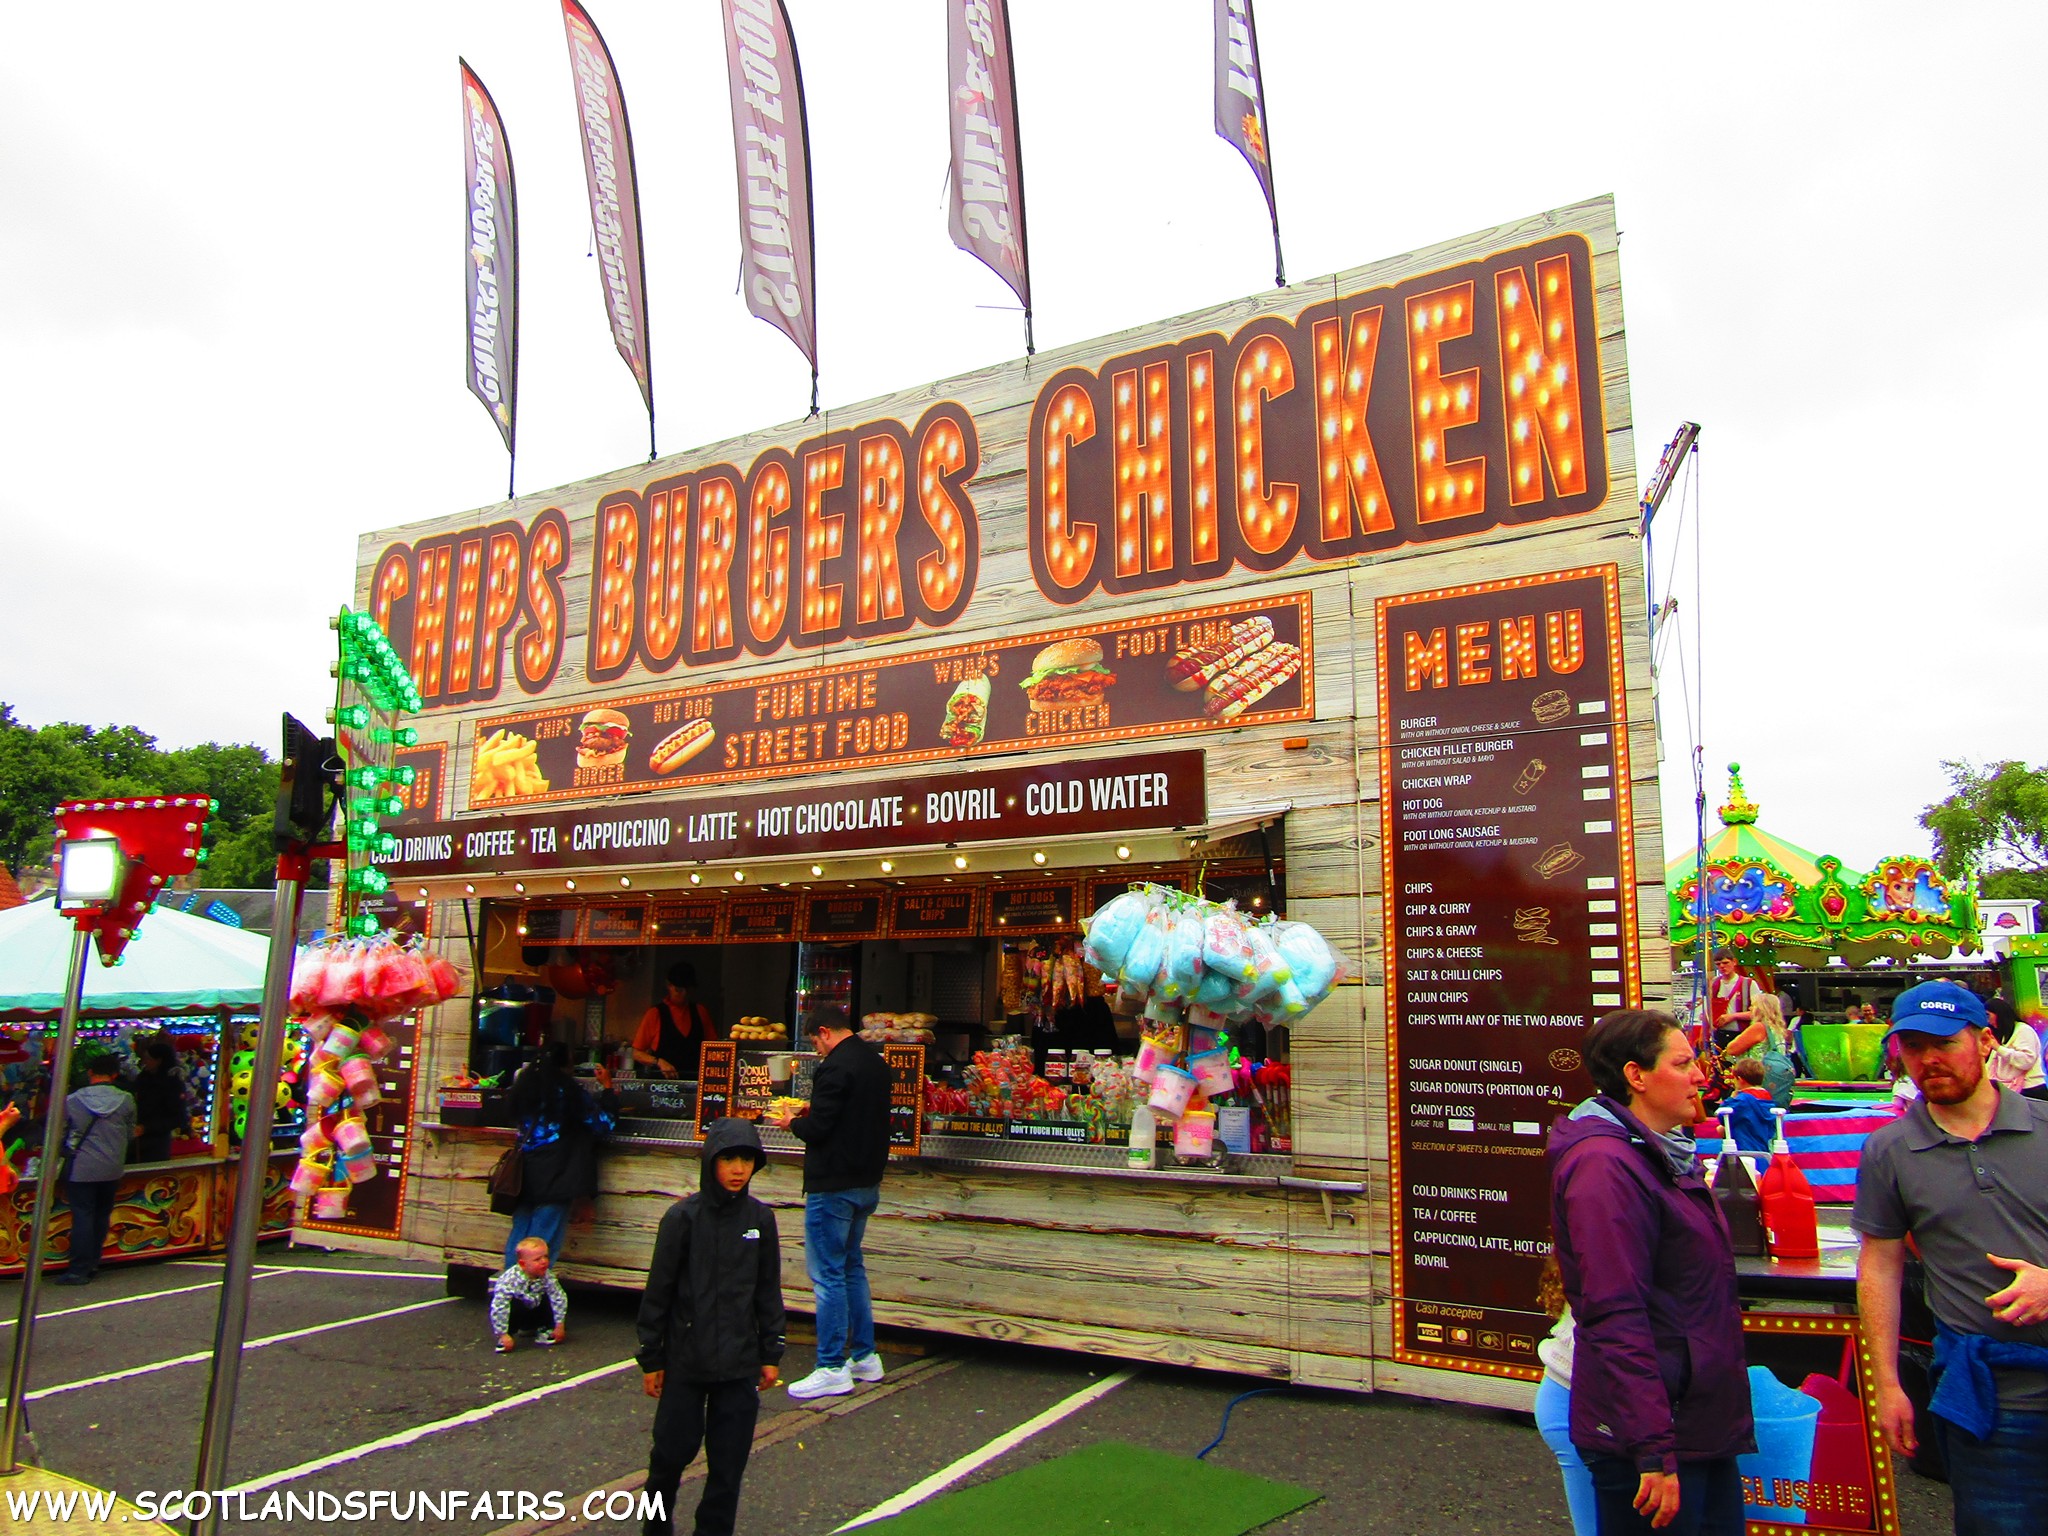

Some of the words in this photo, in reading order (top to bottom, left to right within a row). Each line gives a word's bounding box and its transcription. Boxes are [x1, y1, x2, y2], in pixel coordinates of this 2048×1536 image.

[376, 520, 562, 698] CHIPS
[593, 414, 967, 672] BURGERS
[1044, 254, 1589, 590] CHICKEN
[1115, 627, 1169, 659] FOOT
[1175, 618, 1232, 651] LONG
[1404, 608, 1584, 692] MENU
[931, 652, 1000, 685] WRAPS
[753, 671, 877, 723] FUNTIME
[653, 701, 681, 724] HOT
[684, 696, 713, 719] DOG
[1025, 703, 1111, 736] CHICKEN
[1400, 716, 1436, 729] BURGER
[534, 717, 572, 741] CHIPS
[1425, 727, 1450, 736] WITHOUT
[1450, 726, 1470, 734] ONION,
[1472, 724, 1493, 732] CHEESE
[1501, 721, 1520, 729] SAUCE
[723, 722, 827, 769] STREET
[836, 711, 909, 756] FOOD
[1402, 746, 1440, 759] CHICKEN
[1443, 743, 1472, 755] FILLET
[1475, 740, 1513, 753] BURGER
[1426, 758, 1451, 767] WITHOUT
[1452, 757, 1470, 765] SALAD
[1478, 755, 1494, 763] MAYO
[573, 763, 625, 787] BURGER
[1402, 777, 1441, 790] CHICKEN
[1444, 775, 1472, 787] WRAP
[1403, 799, 1421, 810] HOT
[1423, 798, 1442, 809] DOG
[405, 834, 452, 861] DRINKS
[466, 827, 515, 858] COFFEE
[530, 826, 557, 854] TEA
[572, 816, 670, 852] CAPPUCCINO
[688, 811, 738, 844] LATTE
[757, 804, 794, 838] HOT
[796, 795, 903, 836] CHOCOLATE
[926, 787, 1001, 824] BOVRIL
[1026, 779, 1084, 816] COLD
[1088, 772, 1168, 812] WATER
[1427, 810, 1452, 819] WITHOUT
[1454, 809, 1472, 817] ONION,
[1474, 807, 1500, 816] KETCHUP
[1508, 805, 1536, 814] MUSTARD
[1404, 830, 1426, 841] FOOT
[1429, 828, 1453, 839] LONG
[1456, 826, 1500, 838] SAUSAGE
[1476, 839, 1501, 847] KETCHUP
[1509, 837, 1538, 845] MUSTARD
[1405, 883, 1432, 894] CHIPS
[904, 899, 926, 910] SALT
[1406, 905, 1427, 915] CHIP
[1430, 905, 1437, 914] &
[1440, 903, 1470, 914] CURRY
[920, 909, 945, 921] CHIPS
[1406, 926, 1433, 937] CHIPS
[1436, 926, 1443, 936] &
[1446, 925, 1476, 936] GRAVY
[1407, 948, 1434, 958] CHIPS
[1437, 948, 1444, 958] &
[1447, 947, 1483, 958] CHEESE
[1408, 970, 1428, 980] SALT
[1431, 970, 1438, 980] &
[1441, 970, 1470, 980] CHILLI
[1473, 969, 1502, 980] CHIPS
[1408, 992, 1437, 1002] CAJUN
[1440, 992, 1468, 1002] CHIPS
[1920, 1001, 1955, 1012] CORFU
[1409, 1015, 1436, 1025] CHIPS
[1438, 1015, 1462, 1025] WITH
[1465, 1015, 1485, 1025] ANY
[1488, 1015, 1500, 1025] OF
[1502, 1015, 1521, 1025] THE
[1524, 1015, 1547, 1026] TWO
[1550, 1015, 1583, 1026] ABOVE
[891, 1056, 916, 1068] SALT
[1410, 1059, 1441, 1069] SUGAR
[1444, 1060, 1477, 1070] DONUT
[1480, 1061, 1522, 1073] (SINGLE)
[705, 1066, 728, 1078] CHILLI
[1410, 1081, 1442, 1092] SUGAR
[1445, 1083, 1484, 1094] DONUTS
[1487, 1084, 1533, 1096] (PORTION
[1536, 1085, 1549, 1096] OF
[1552, 1086, 1562, 1100] 4)
[1411, 1104, 1442, 1115] CANDY
[1445, 1105, 1475, 1117] FLOSS
[981, 1123, 1004, 1132] LOLLYS
[1010, 1125, 1029, 1135] DON'T
[1029, 1126, 1050, 1135] TOUCH
[1052, 1127, 1063, 1136] THE
[1064, 1127, 1085, 1137] LOLLYS
[1412, 1142, 1445, 1151] SELECTION
[1457, 1144, 1482, 1153] SWEETS
[1491, 1146, 1545, 1156] CONFECTIONERY
[1413, 1185, 1437, 1196] COLD
[1441, 1187, 1476, 1199] DRINKS
[1480, 1189, 1507, 1201] FROM
[1413, 1208, 1431, 1219] TEA
[1434, 1210, 1437, 1220] /
[1441, 1210, 1476, 1223] COFFEE
[1414, 1231, 1477, 1248] CAPPUCCINO,
[1480, 1237, 1511, 1251] LATTE,
[1514, 1240, 1534, 1252] HOT
[1415, 1254, 1449, 1268] BOVRIL
[1416, 1302, 1438, 1314] Cash
[1440, 1306, 1483, 1320] accepted
[1421, 1328, 1439, 1337] VISA
